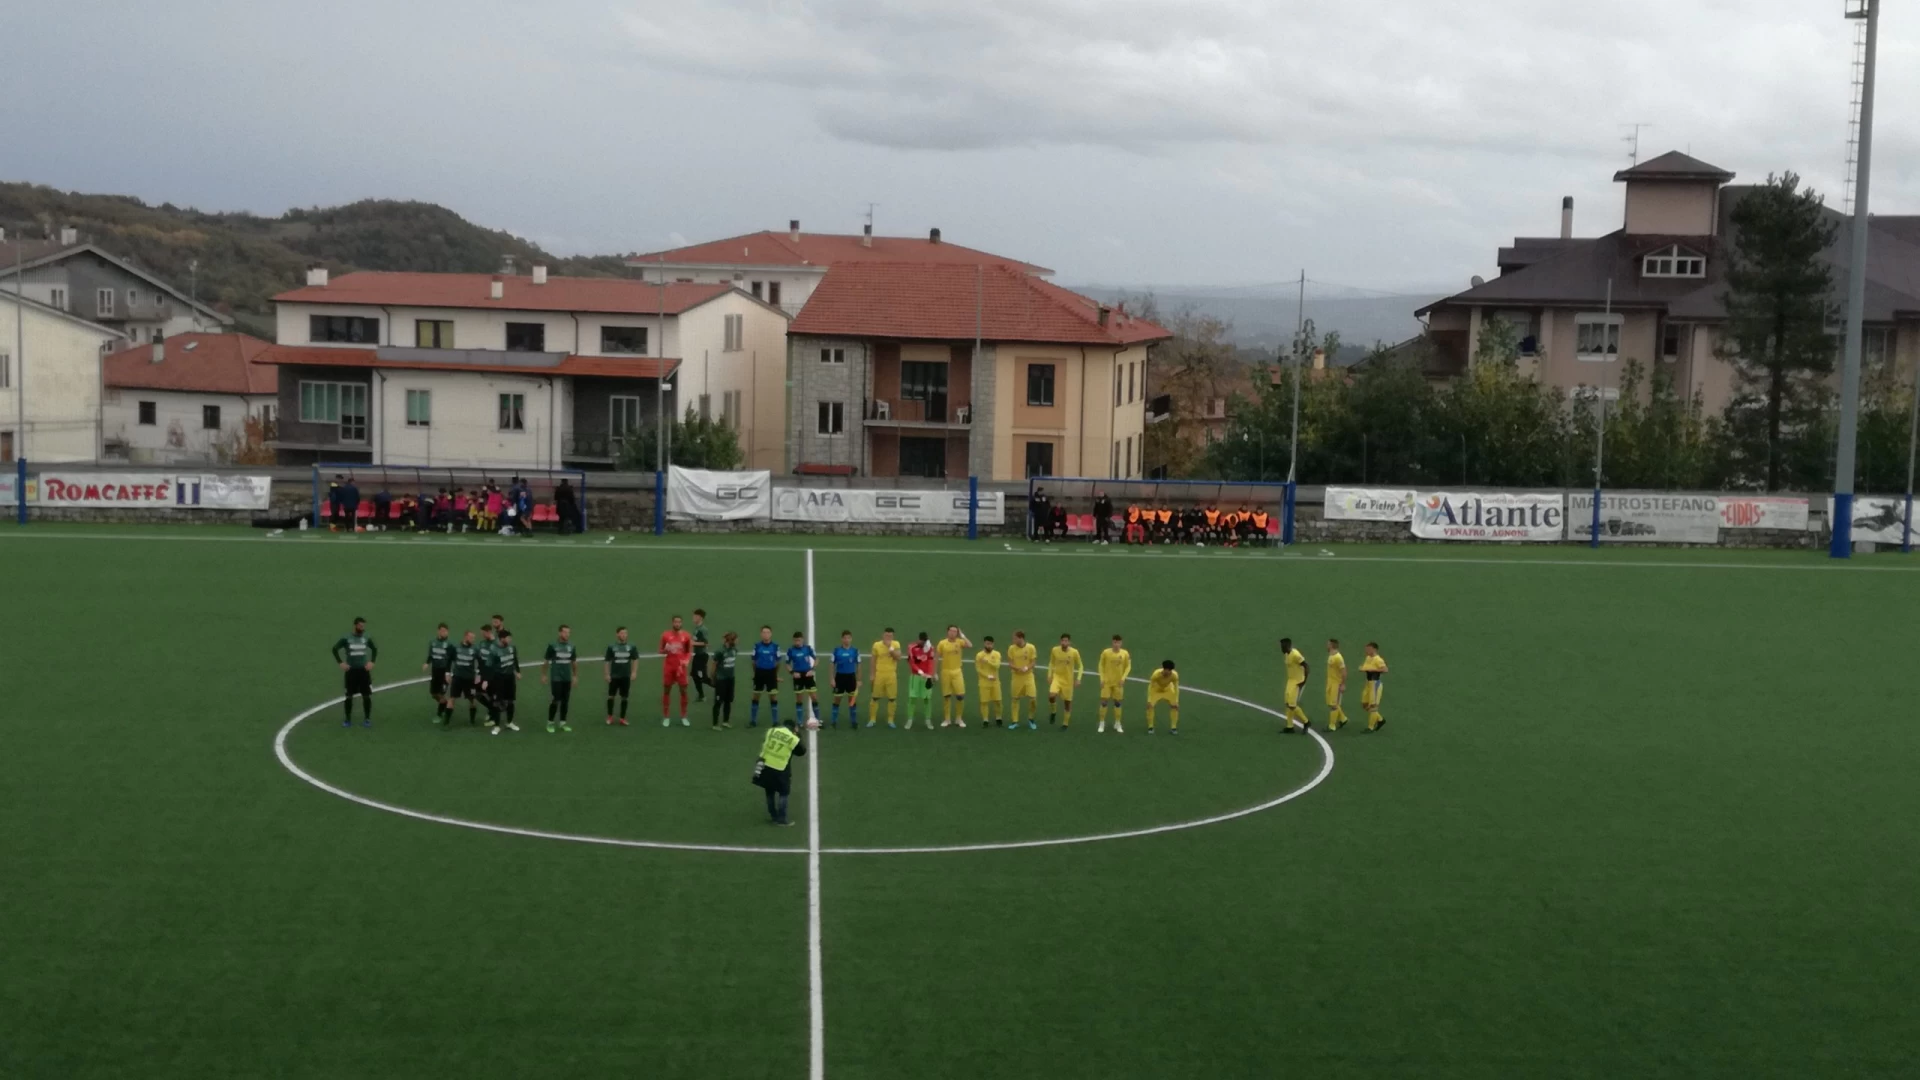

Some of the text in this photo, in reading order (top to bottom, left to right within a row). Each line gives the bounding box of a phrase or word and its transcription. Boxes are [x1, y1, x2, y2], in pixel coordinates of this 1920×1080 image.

[716, 487, 758, 499] GC
[807, 491, 844, 507] AFA
[876, 496, 921, 508] GC
[1571, 496, 1716, 512] MASTROSTEFANO
[1431, 496, 1561, 528] Atlante
